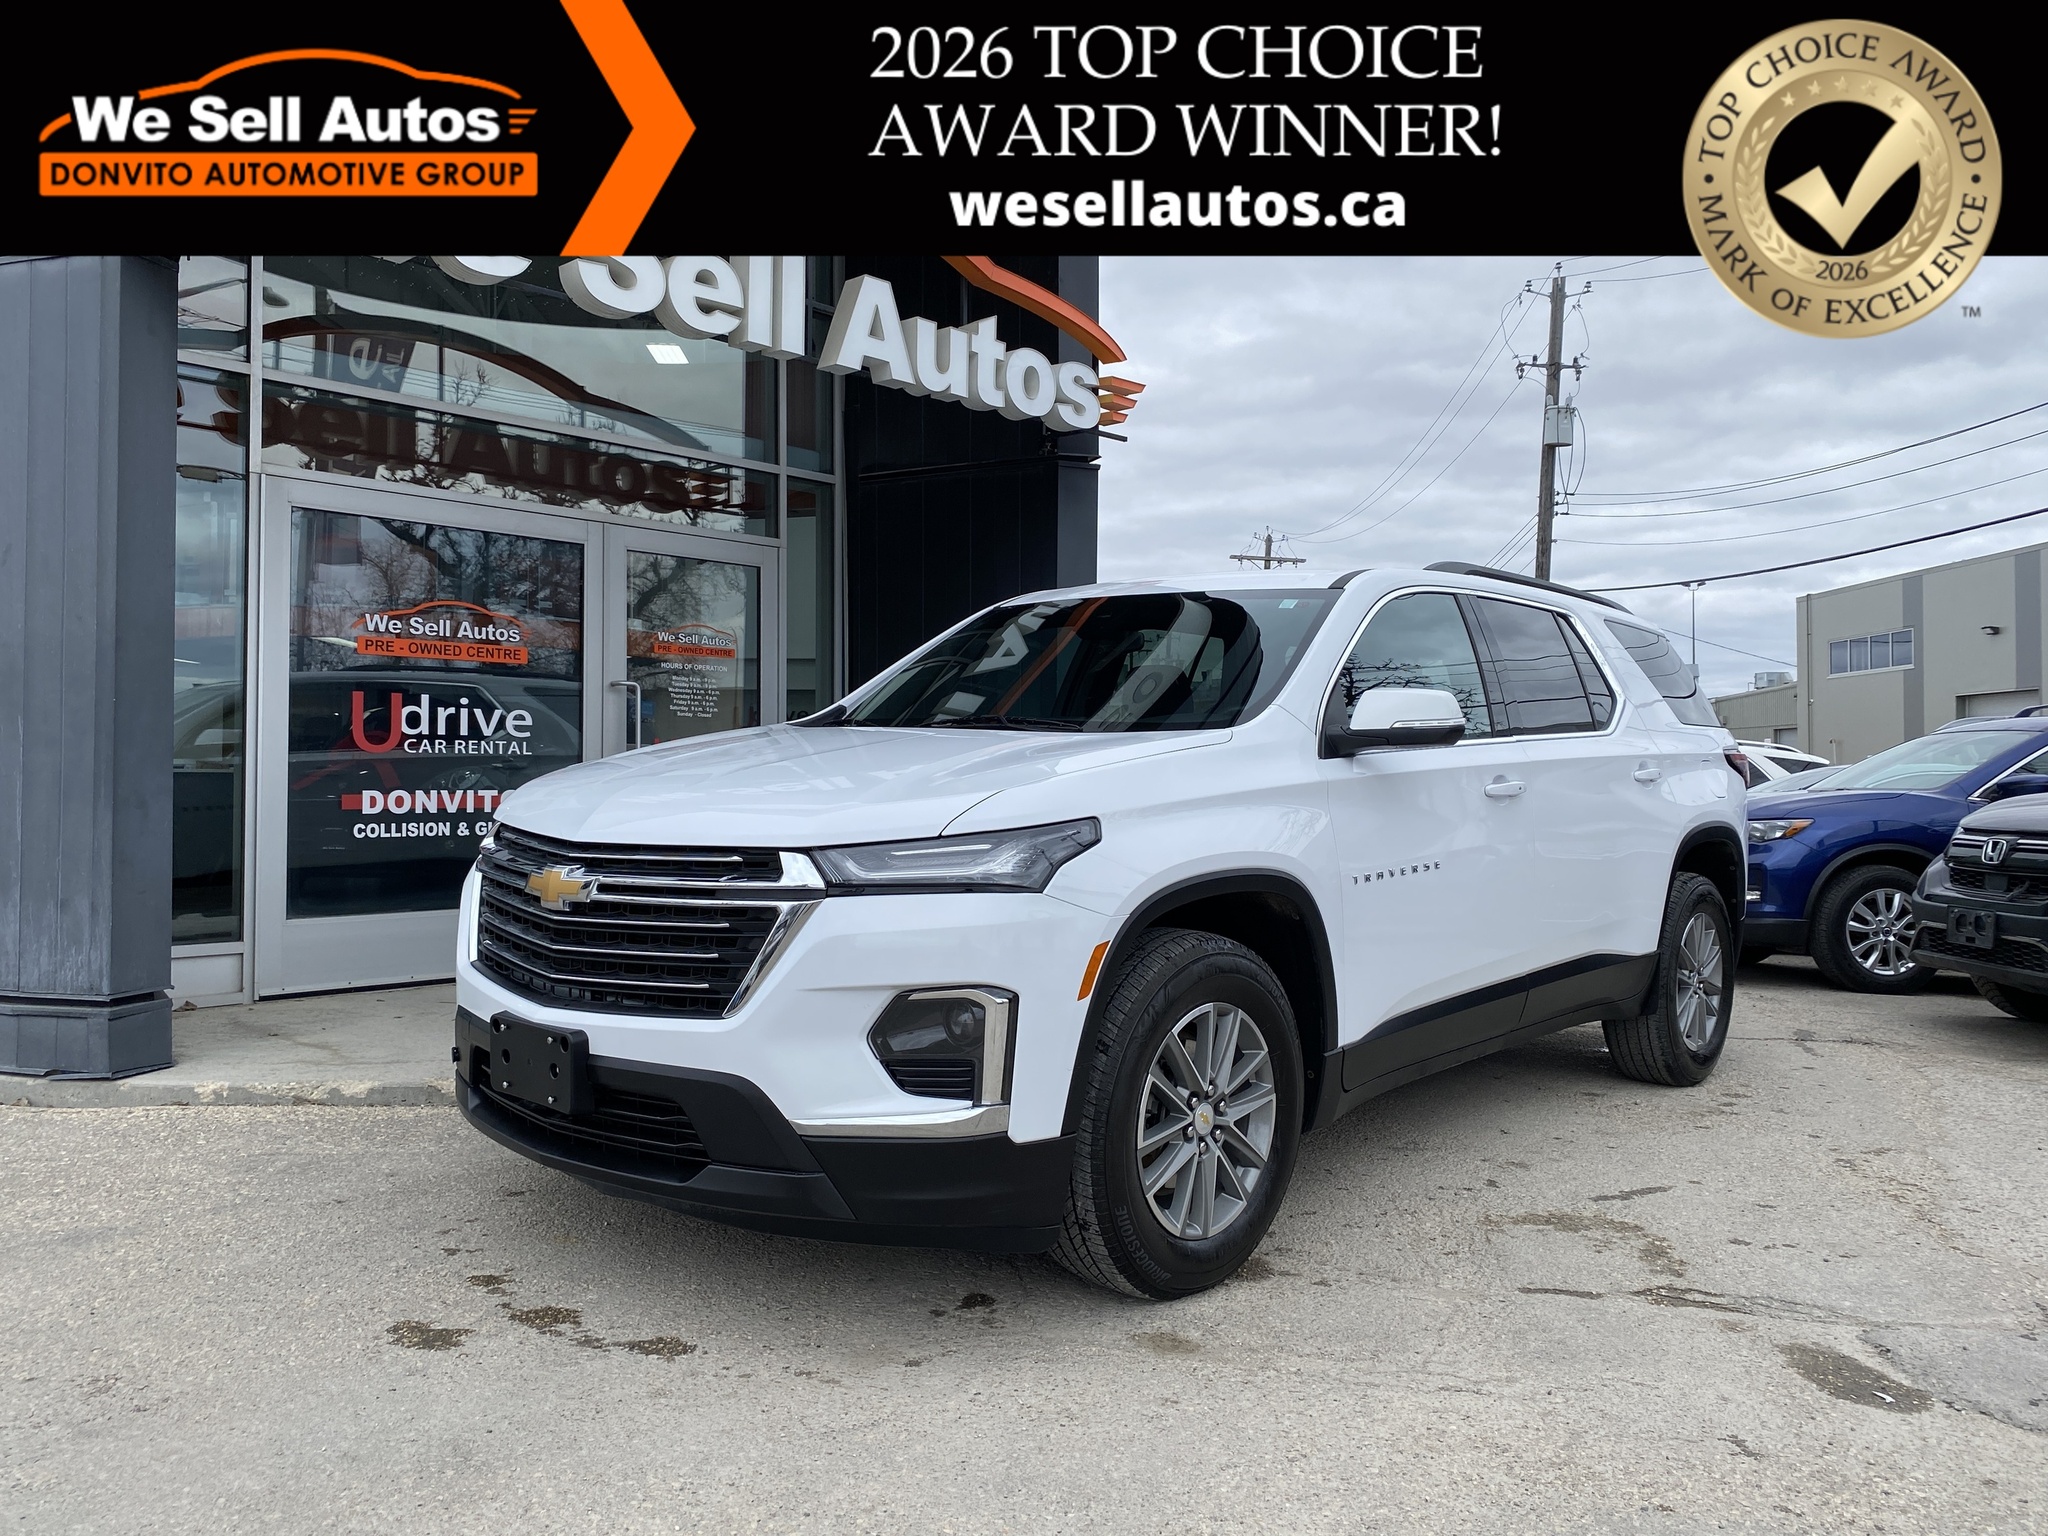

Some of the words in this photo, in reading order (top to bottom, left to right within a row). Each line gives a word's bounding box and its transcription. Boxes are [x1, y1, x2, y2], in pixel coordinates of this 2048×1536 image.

[817, 274, 1100, 432] Autos
[364, 613, 402, 633] We
[409, 617, 450, 637] Sell
[457, 622, 520, 642] Autos
[657, 631, 675, 642] We
[678, 633, 698, 644] Sell
[701, 635, 732, 646] Autos
[365, 639, 395, 653] PRE
[408, 641, 462, 657] OWNED
[467, 646, 522, 661] CENTRE
[678, 647, 704, 655] OWNED
[705, 648, 732, 657] CENTRE
[694, 664, 728, 672] OPERATION
[352, 690, 533, 754] Udrive
[403, 739, 447, 754] CAR
[454, 740, 533, 755] RENTAL
[361, 789, 517, 815] DONVIT
[353, 821, 450, 838] COLLISION
[457, 821, 470, 837] &
[1352, 860, 1441, 885] TRAVERSE
[1114, 1205, 1172, 1286] BRIDGESTONE
